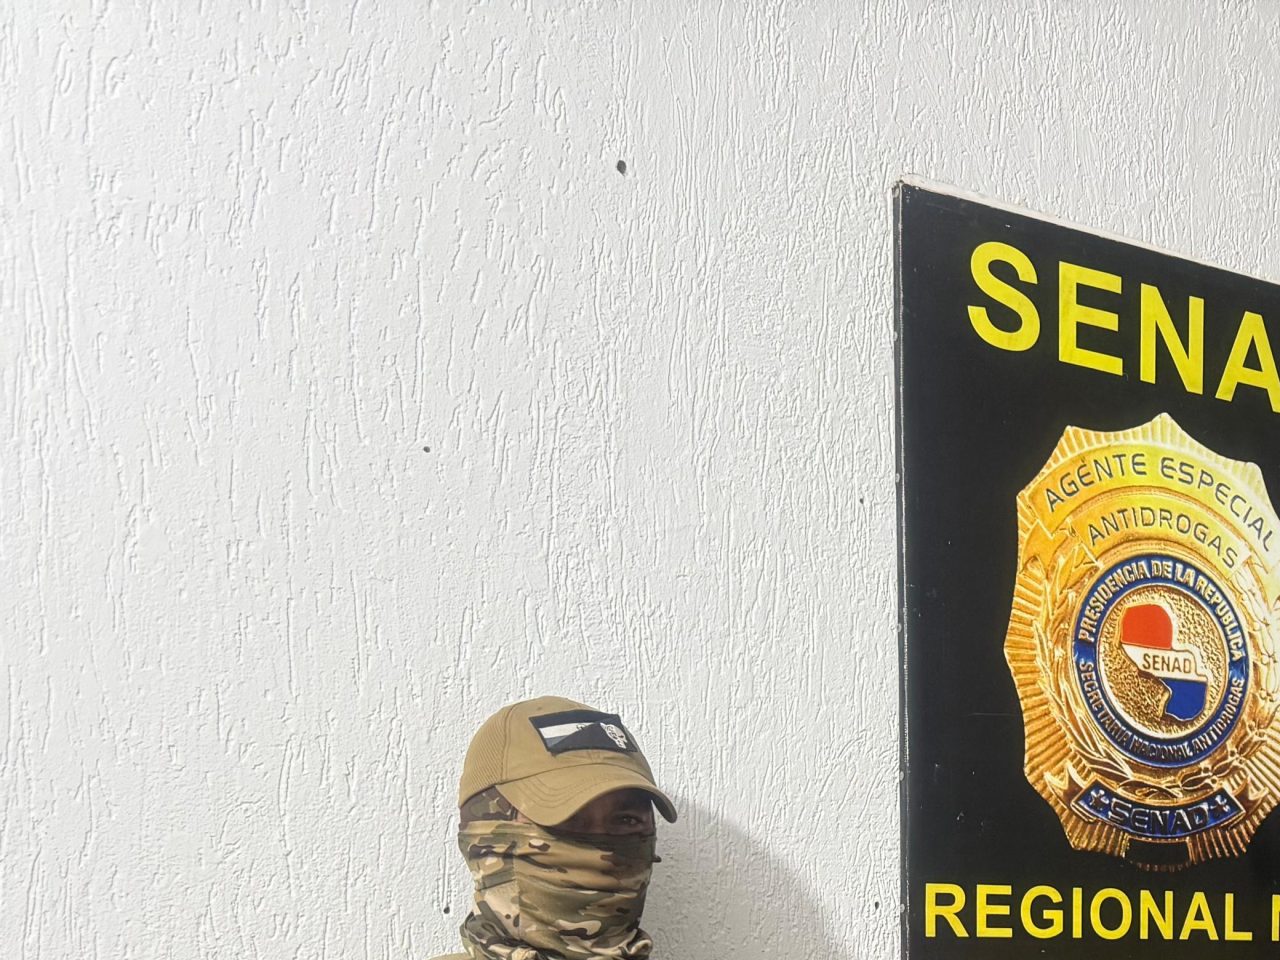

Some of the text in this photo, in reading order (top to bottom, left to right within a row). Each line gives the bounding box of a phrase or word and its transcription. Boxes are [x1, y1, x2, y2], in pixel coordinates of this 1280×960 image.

[1045, 453, 1277, 552] AGENTE ESPECIAL
[1087, 507, 1238, 570] ANTIDROGAS
[1078, 560, 1150, 643] PRESIDENCIA
[1150, 560, 1173, 579] DE
[1174, 563, 1196, 587] LA
[1142, 653, 1192, 674] SENAD
[1193, 678, 1246, 754] ANTIDROGAS
[1108, 798, 1209, 833] SENAD
[924, 883, 1252, 941] REGIONAL
